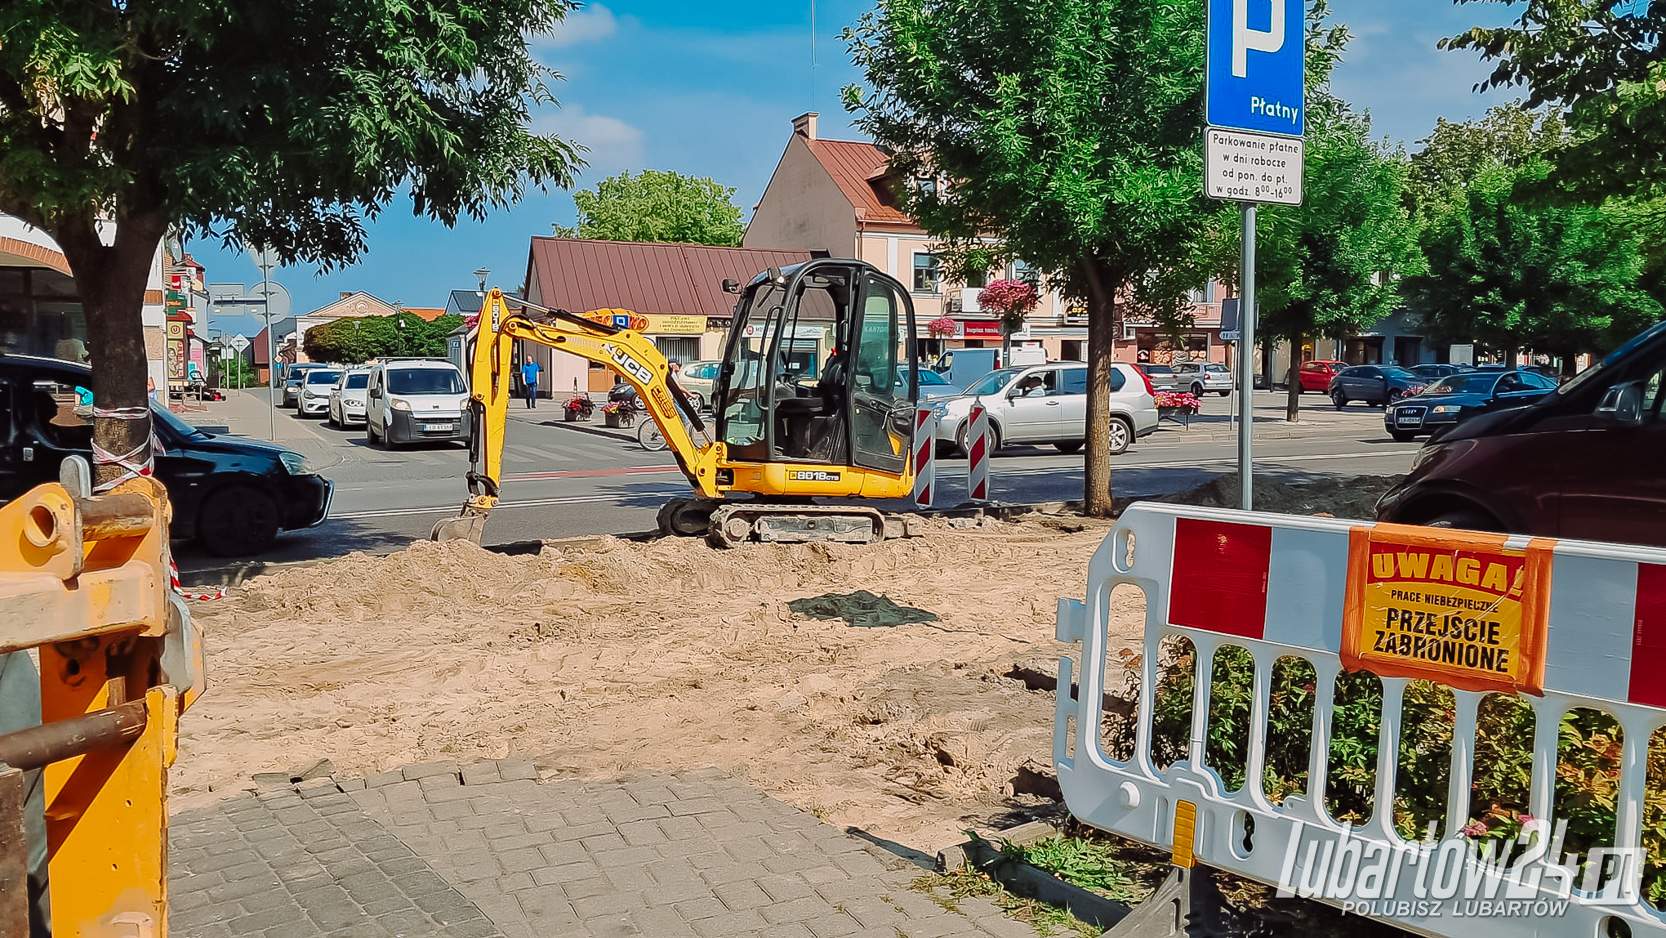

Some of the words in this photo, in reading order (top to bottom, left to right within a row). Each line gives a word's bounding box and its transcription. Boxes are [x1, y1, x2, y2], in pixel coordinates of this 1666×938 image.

[1251, 96, 1299, 125] Płatny
[1213, 133, 1266, 150] Parkowanie
[1269, 141, 1299, 154] płatne
[1233, 151, 1248, 165] dni
[1250, 156, 1286, 168] robocze
[1222, 168, 1234, 178] od
[1237, 171, 1258, 183] pon.
[1261, 172, 1273, 183] do
[1275, 174, 1288, 184] pt.
[1216, 185, 1223, 193] w
[612, 349, 653, 385] JCB
[1391, 589, 1421, 603] PRACE
[1424, 593, 1499, 613] NIEBEZPIECZNE
[1386, 607, 1500, 645] PRZEJŚCIE
[1373, 630, 1509, 673] ZABRONIONE
